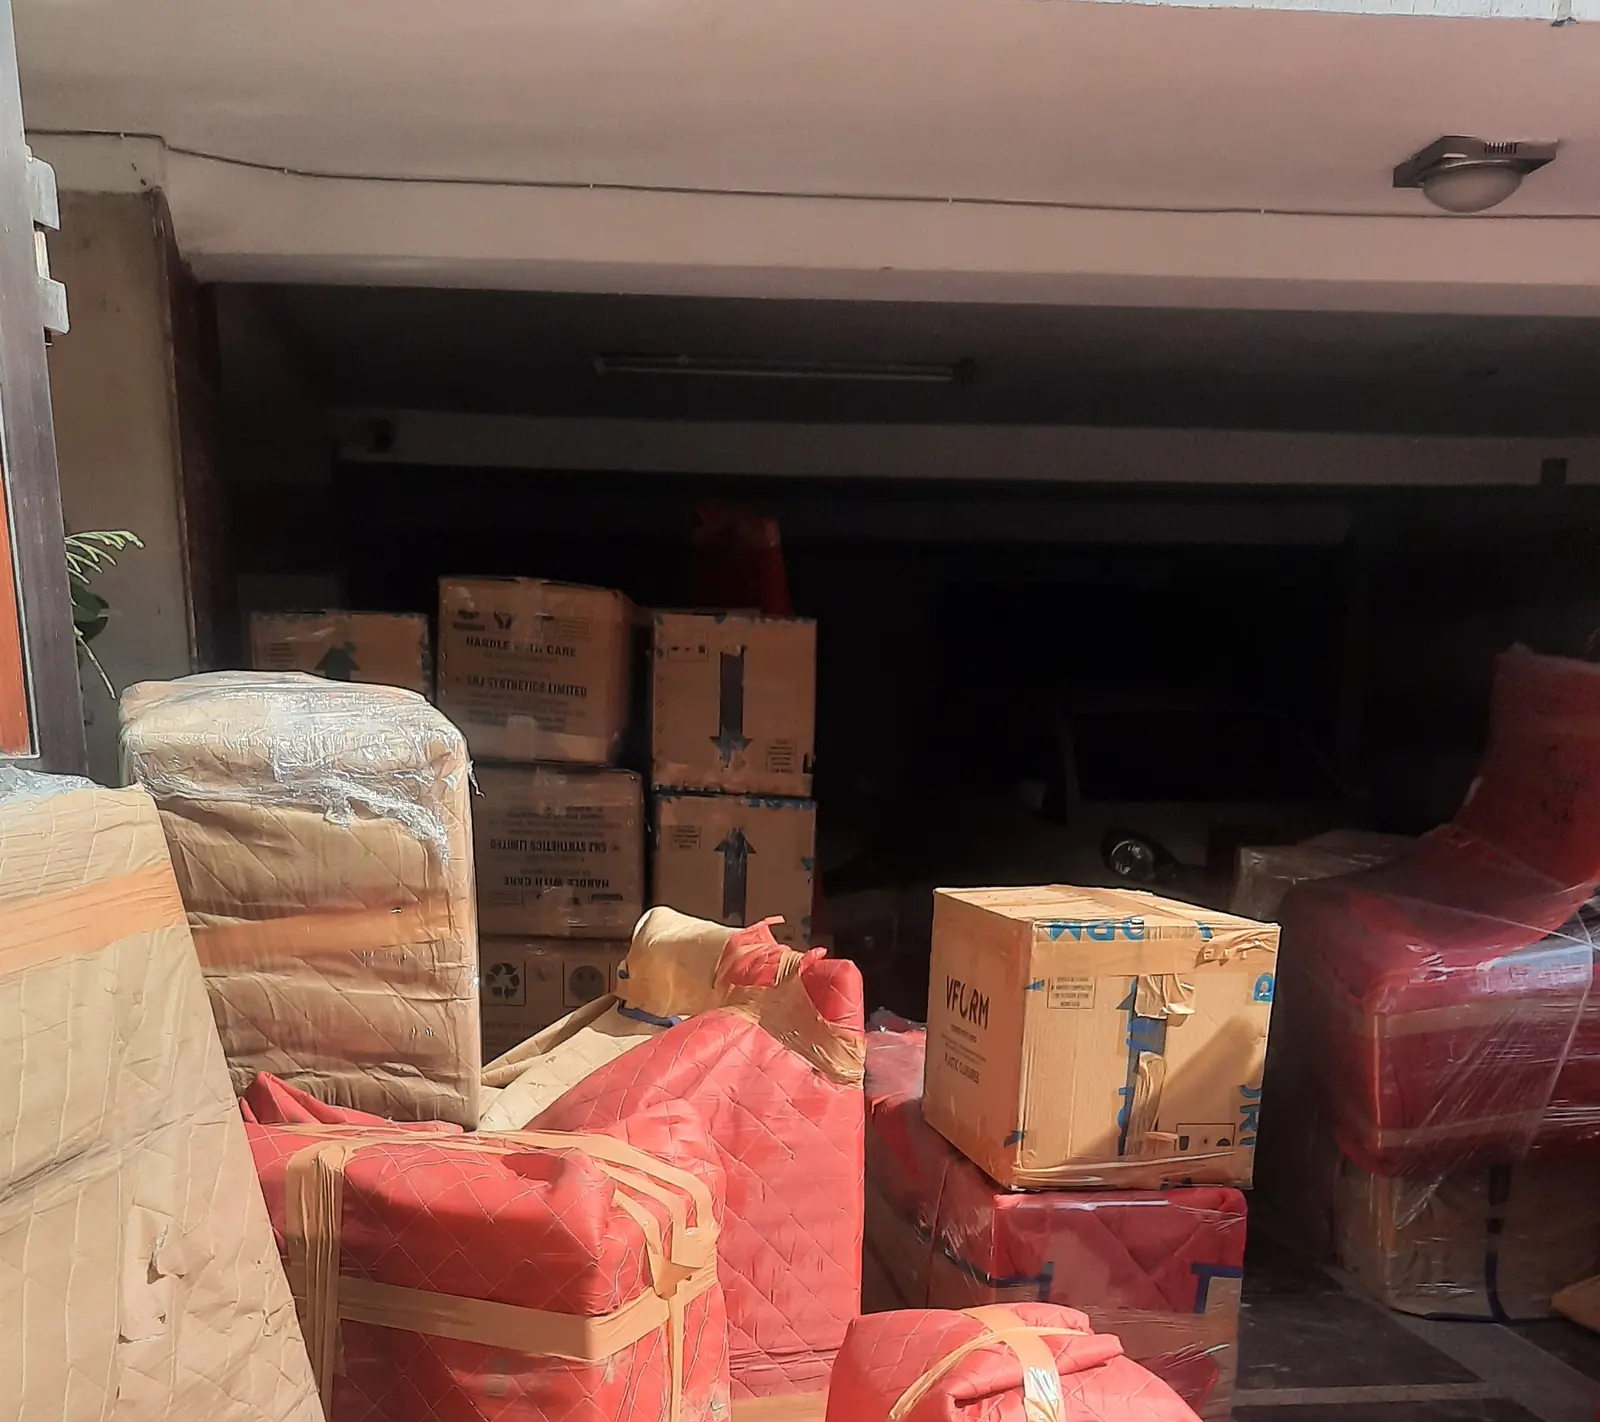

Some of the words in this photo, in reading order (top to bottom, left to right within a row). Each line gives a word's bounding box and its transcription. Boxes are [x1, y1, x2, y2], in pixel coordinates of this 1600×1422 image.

[466, 636, 510, 651] HANDLE
[546, 644, 577, 657] CARE
[488, 676, 546, 693] SYNTHETICS
[548, 682, 588, 698] LIMITED
[490, 838, 528, 851] LIMITED
[504, 875, 532, 887] CARE
[567, 877, 610, 889] HANDLE
